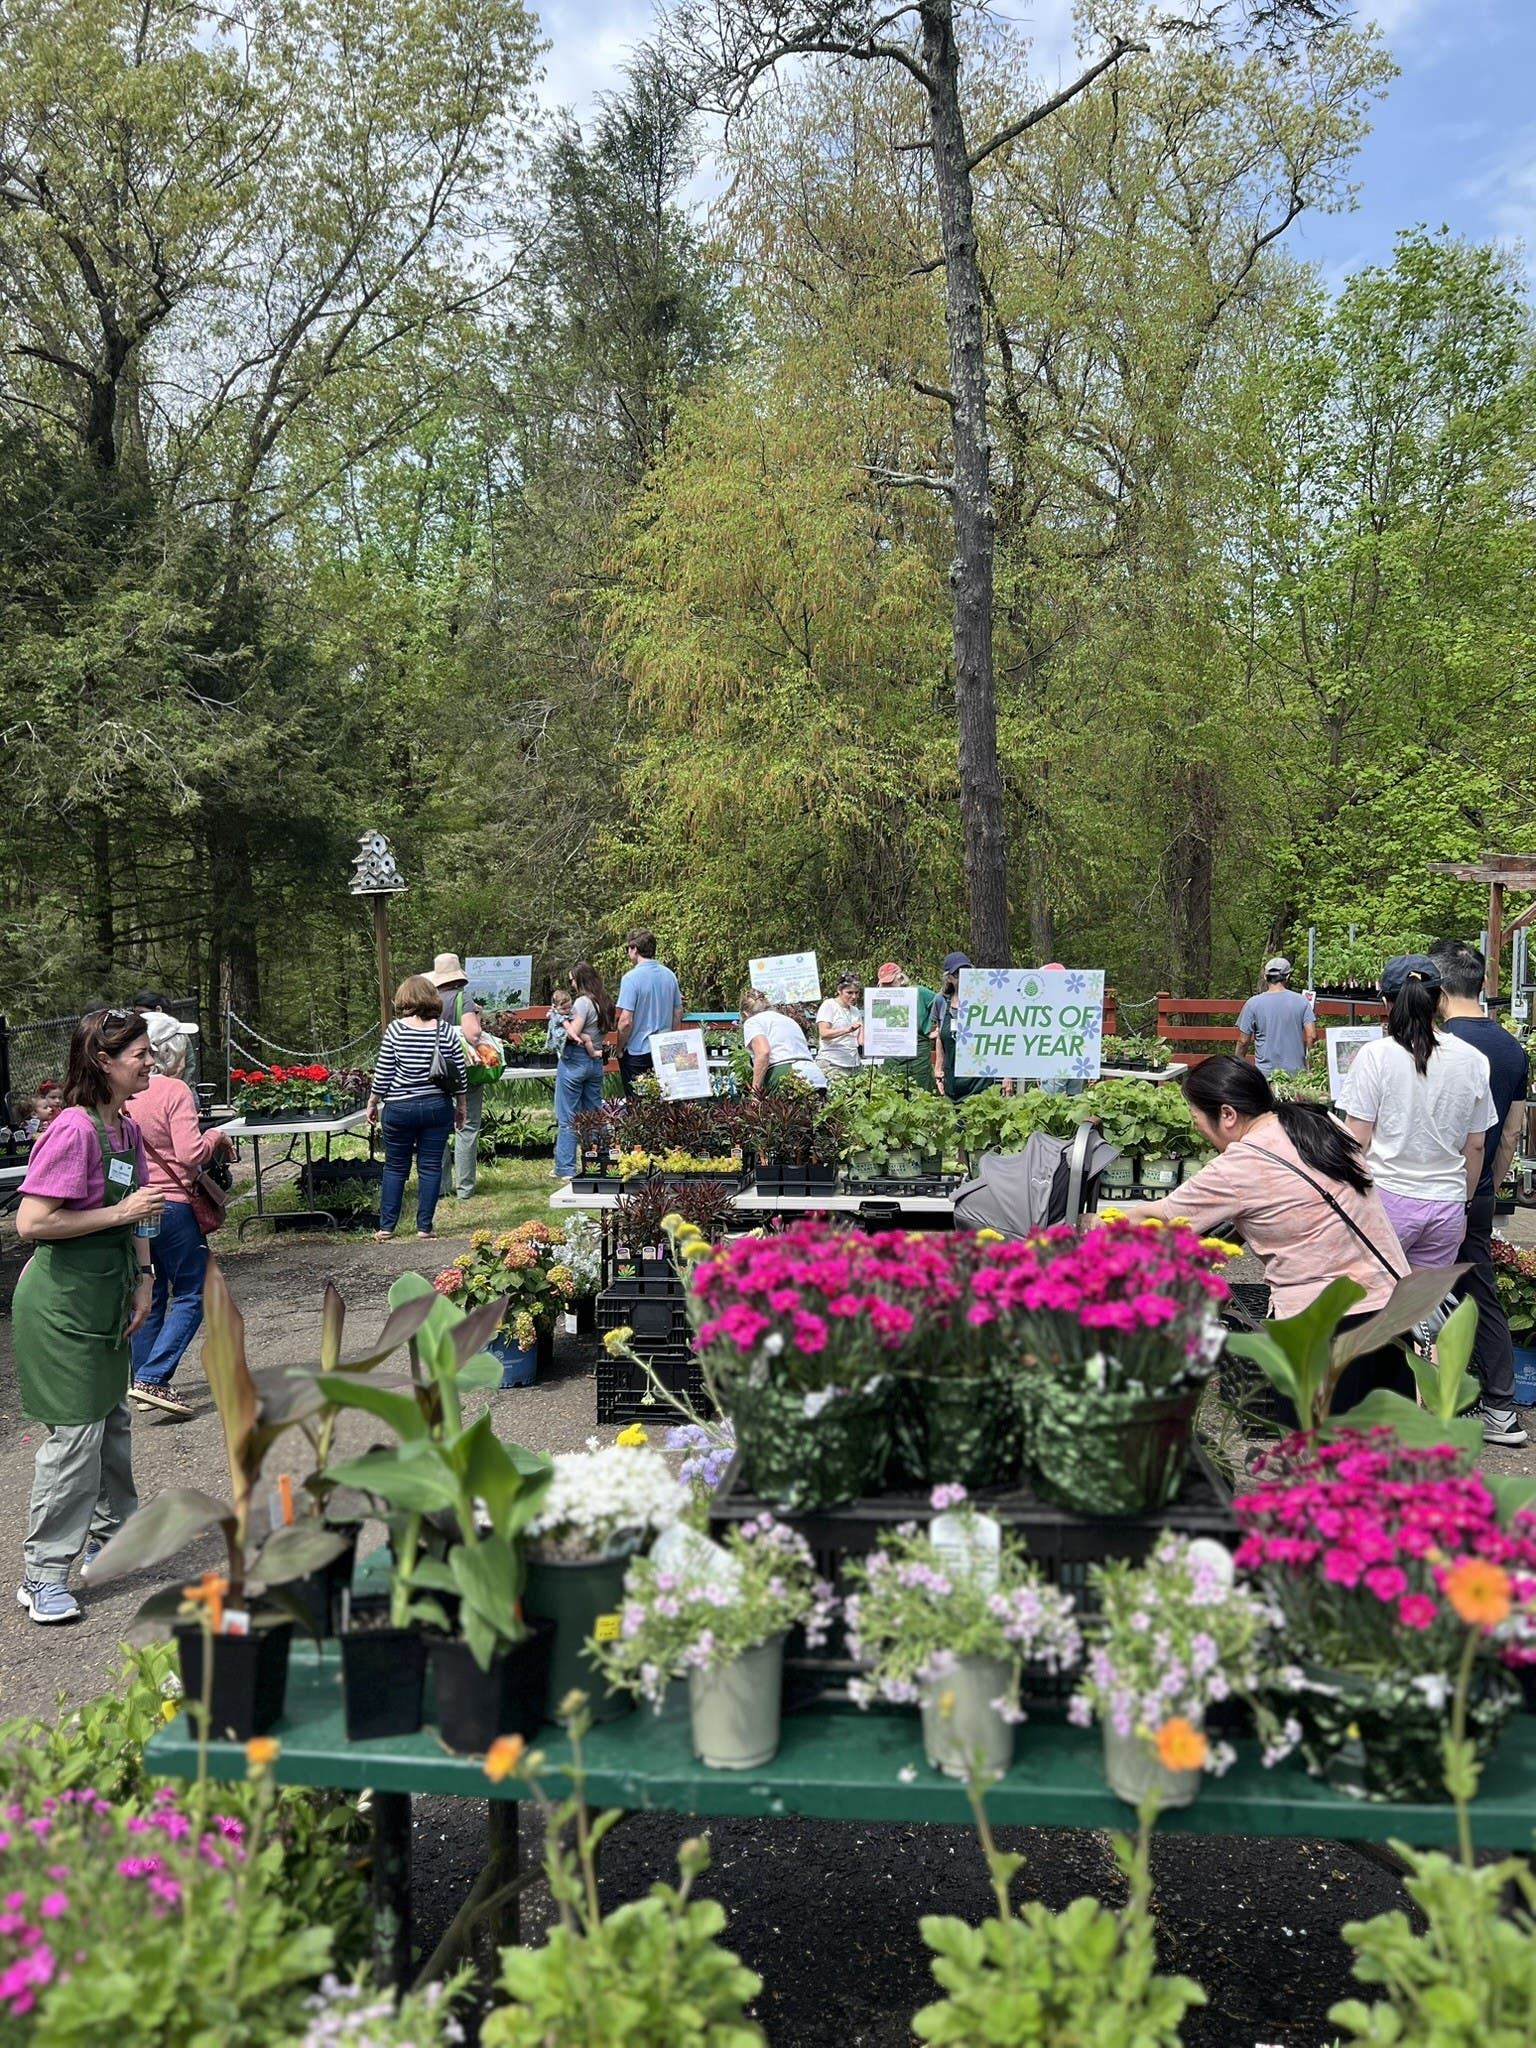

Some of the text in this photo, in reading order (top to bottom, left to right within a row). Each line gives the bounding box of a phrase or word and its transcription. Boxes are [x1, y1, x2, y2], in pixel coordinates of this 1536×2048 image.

[966, 1005, 1096, 1028] PLANTS OF
[973, 1034, 1085, 1057] THE YEAR
